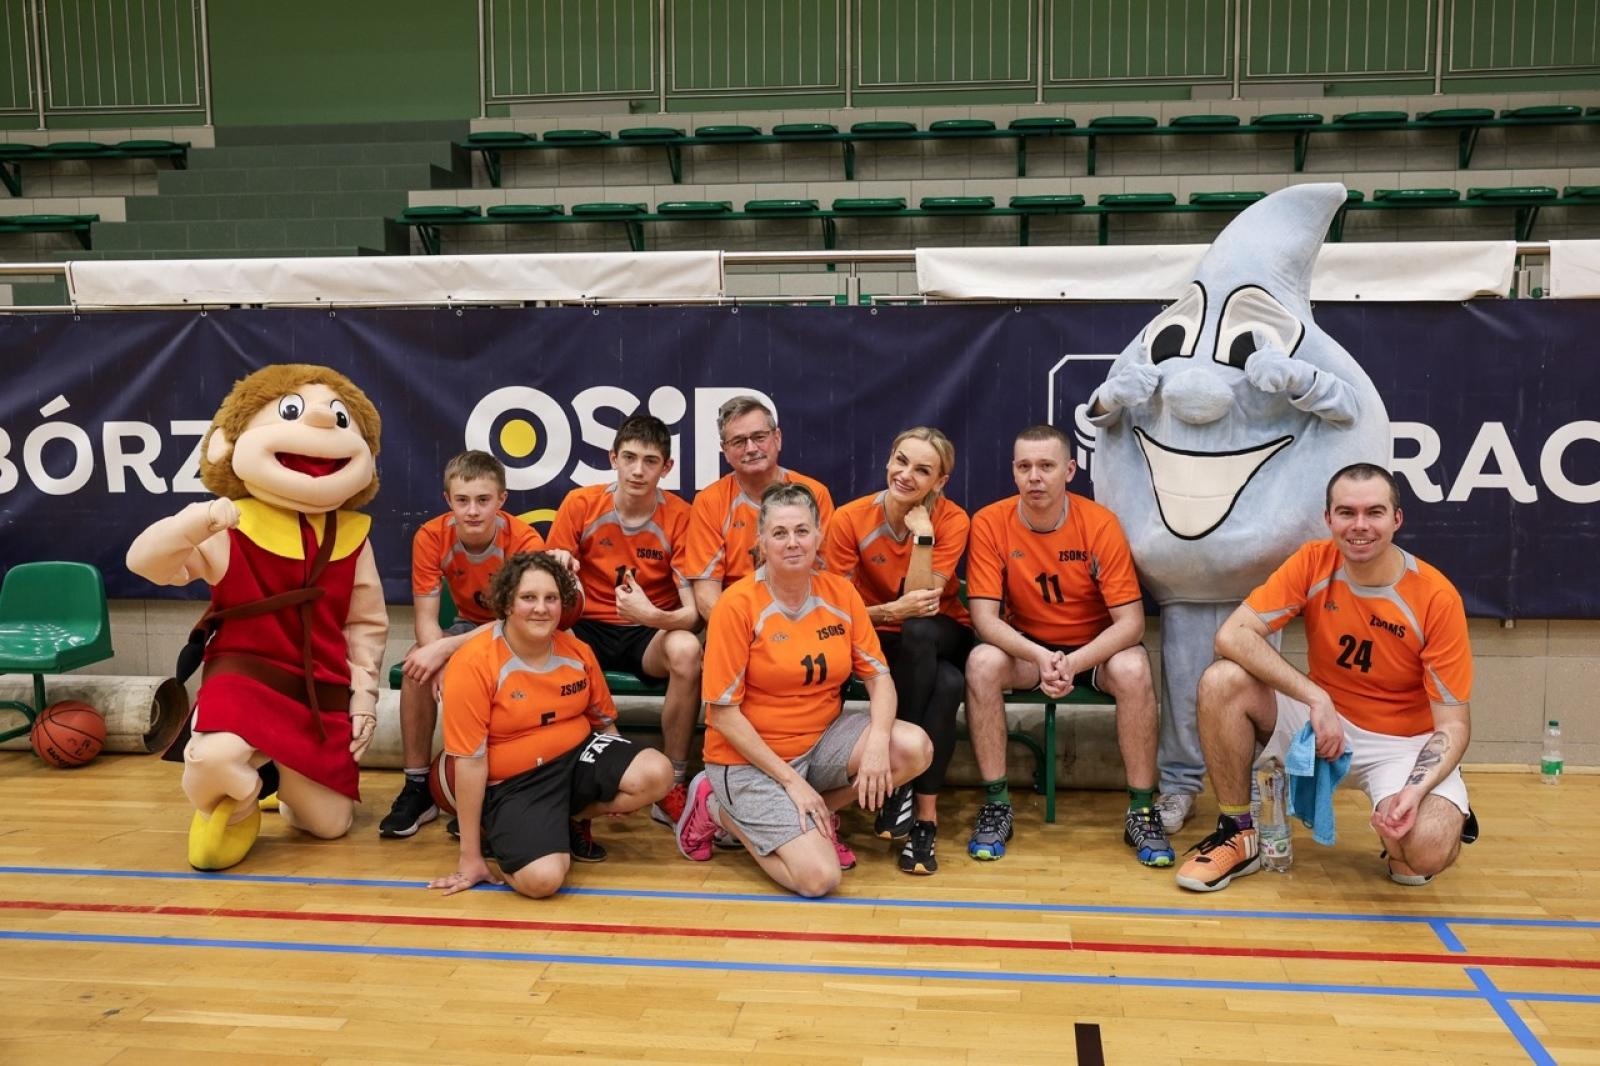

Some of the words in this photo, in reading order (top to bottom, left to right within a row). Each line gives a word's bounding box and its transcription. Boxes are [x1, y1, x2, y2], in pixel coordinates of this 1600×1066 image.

[1035, 572, 1064, 603] 11
[801, 653, 827, 686] 11
[1336, 634, 1373, 673] 24
